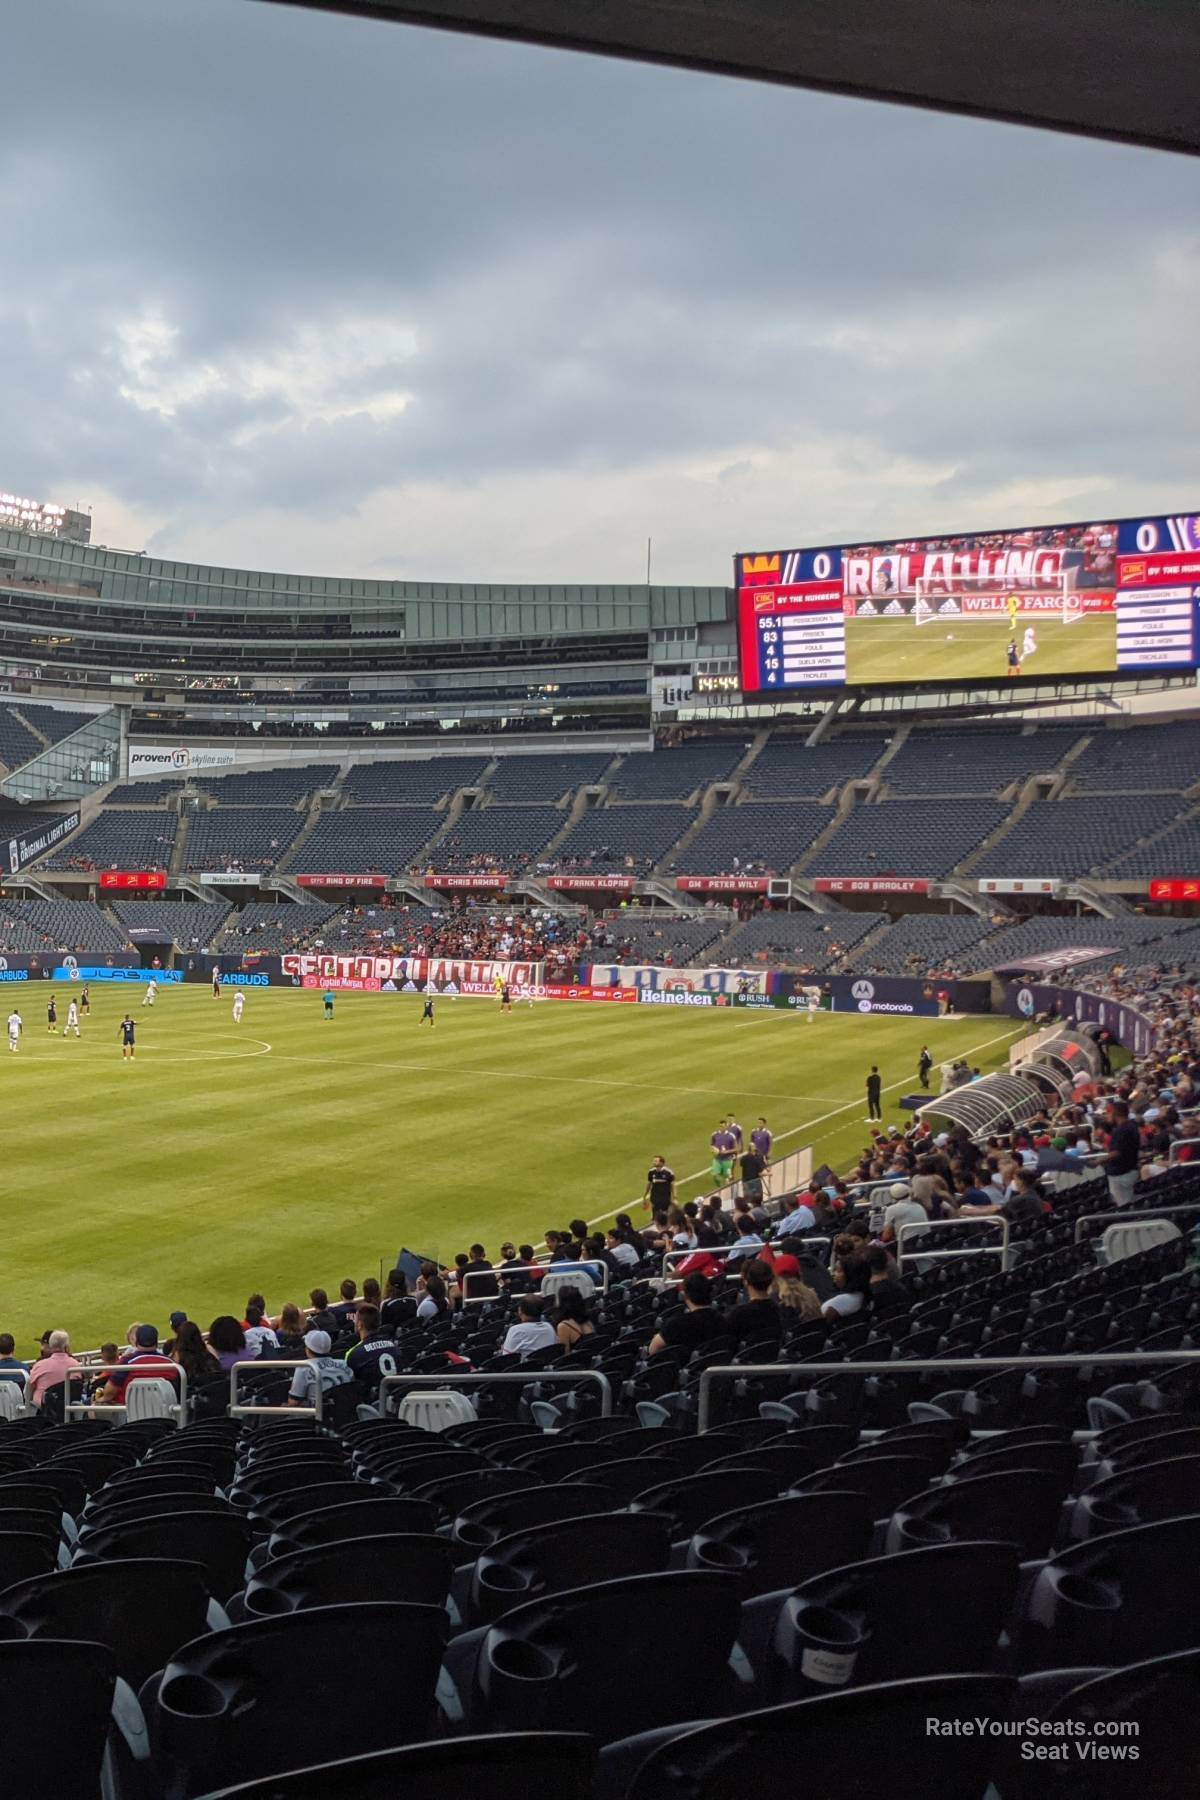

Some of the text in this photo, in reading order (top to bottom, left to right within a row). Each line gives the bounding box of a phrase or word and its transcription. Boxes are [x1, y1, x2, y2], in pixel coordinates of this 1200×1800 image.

[1136, 524, 1158, 552] 0
[813, 553, 831, 579] 0
[789, 595, 804, 603] THE
[805, 592, 840, 602] NUMBERS
[1024, 596, 1080, 609] FARGO
[759, 616, 782, 629] 55.1
[763, 631, 778, 643] 83
[767, 645, 775, 655] 4
[765, 658, 779, 669] 15
[768, 672, 776, 682] 4
[662, 688, 692, 706] Lite
[131, 752, 234, 765] proven IT skyline suite
[20, 813, 79, 862] ORIGINAL LIGHT BEER
[432, 878, 441, 886] 14
[568, 879, 595, 887] FRANK
[598, 879, 629, 887] KLOPAS
[708, 880, 735, 888] PETER
[738, 880, 758, 888] WILT
[830, 881, 915, 890] HC BOB BRADLEY
[219, 973, 270, 985] EARBUDS
[463, 982, 501, 993] WELL
[641, 990, 712, 1005] Heineken
[746, 994, 770, 1003] RUSH
[872, 1002, 914, 1012] motorola
